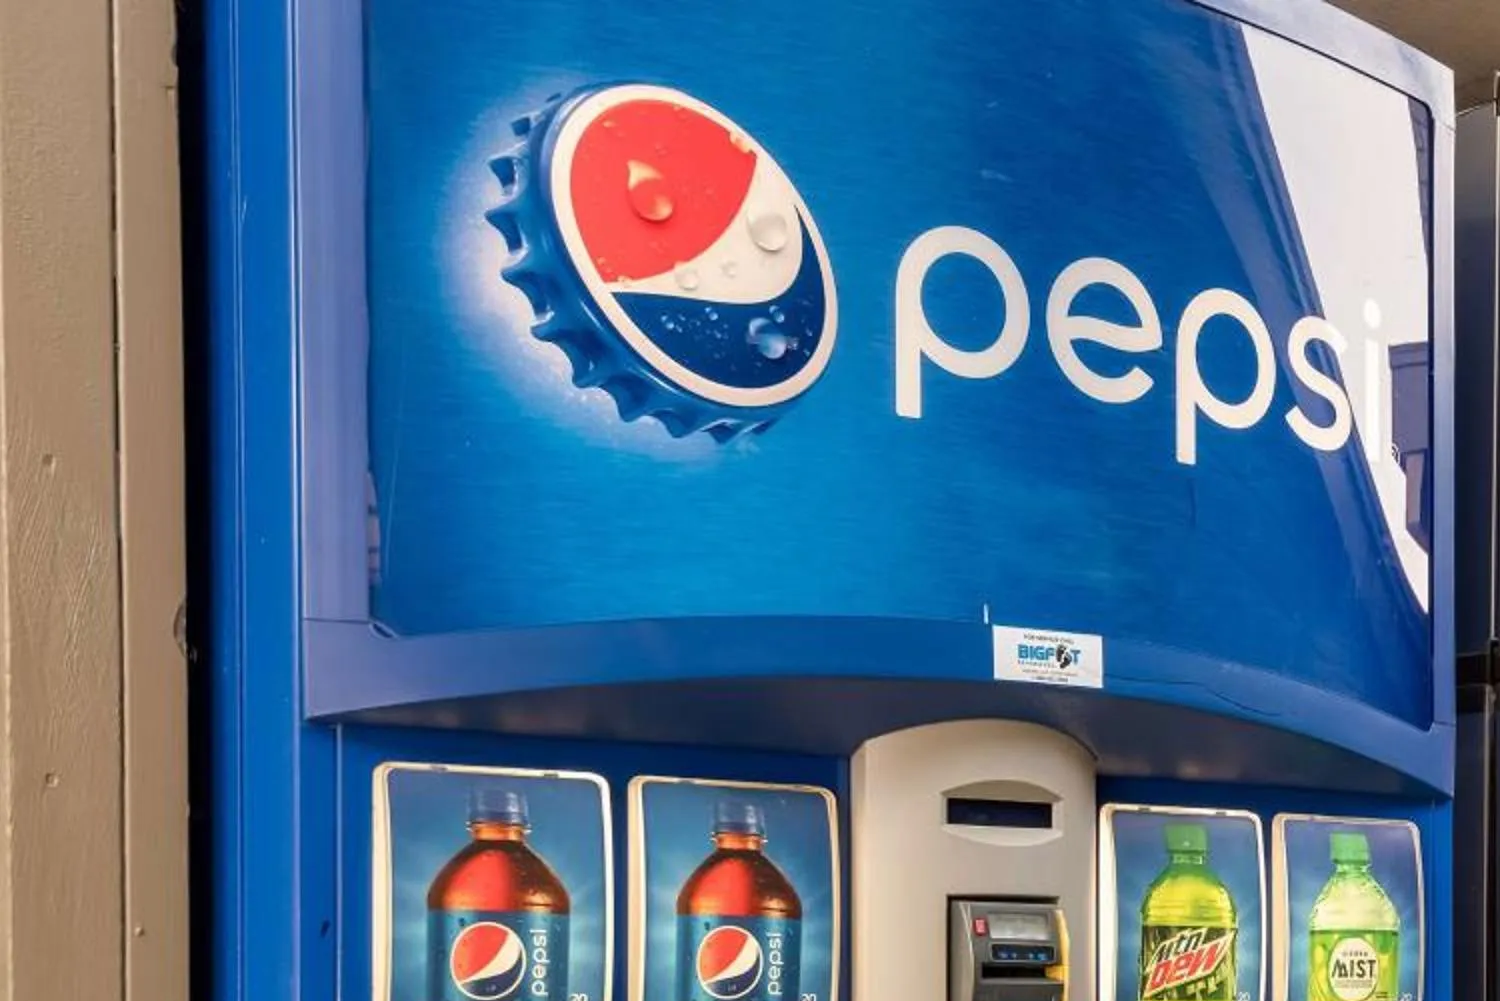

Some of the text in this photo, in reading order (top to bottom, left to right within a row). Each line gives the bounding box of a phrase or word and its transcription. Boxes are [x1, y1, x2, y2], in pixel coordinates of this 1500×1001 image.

[896, 226, 1383, 465] pepsi
[531, 928, 549, 997] pepsi
[766, 931, 783, 996] pepsi
[1331, 959, 1377, 978] MIST
